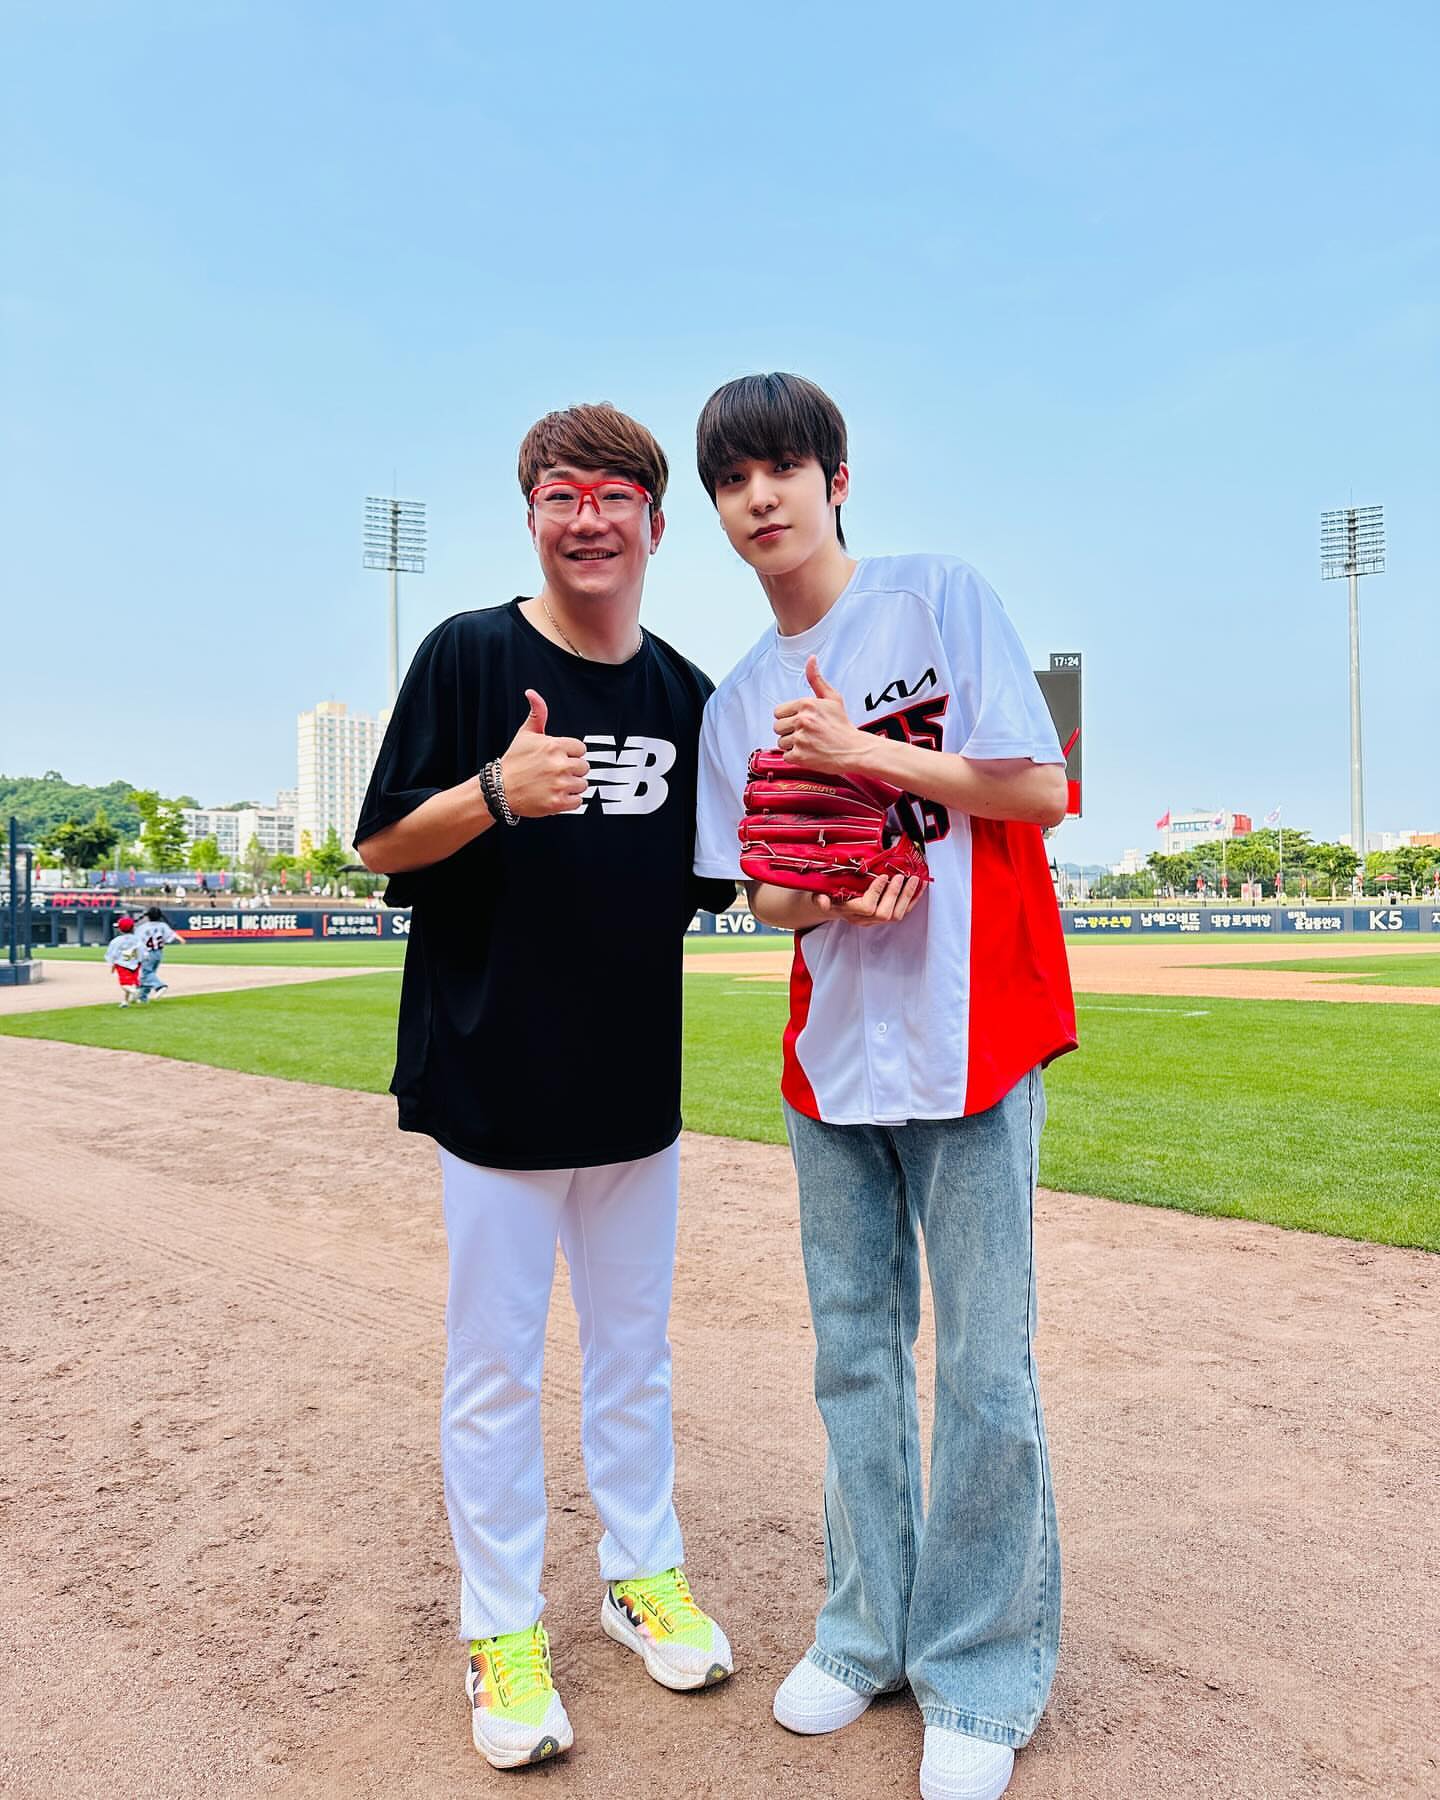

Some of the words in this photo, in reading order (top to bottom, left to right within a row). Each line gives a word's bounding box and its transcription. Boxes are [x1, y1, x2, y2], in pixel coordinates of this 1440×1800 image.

[1054, 656, 1079, 667] 17:24
[189, 915, 238, 930] 인크커피
[261, 915, 297, 930] COFFEE
[715, 914, 756, 933] EV6
[1087, 916, 1132, 928] 광주은행
[1369, 910, 1403, 930] K5
[145, 936, 165, 951] 42
